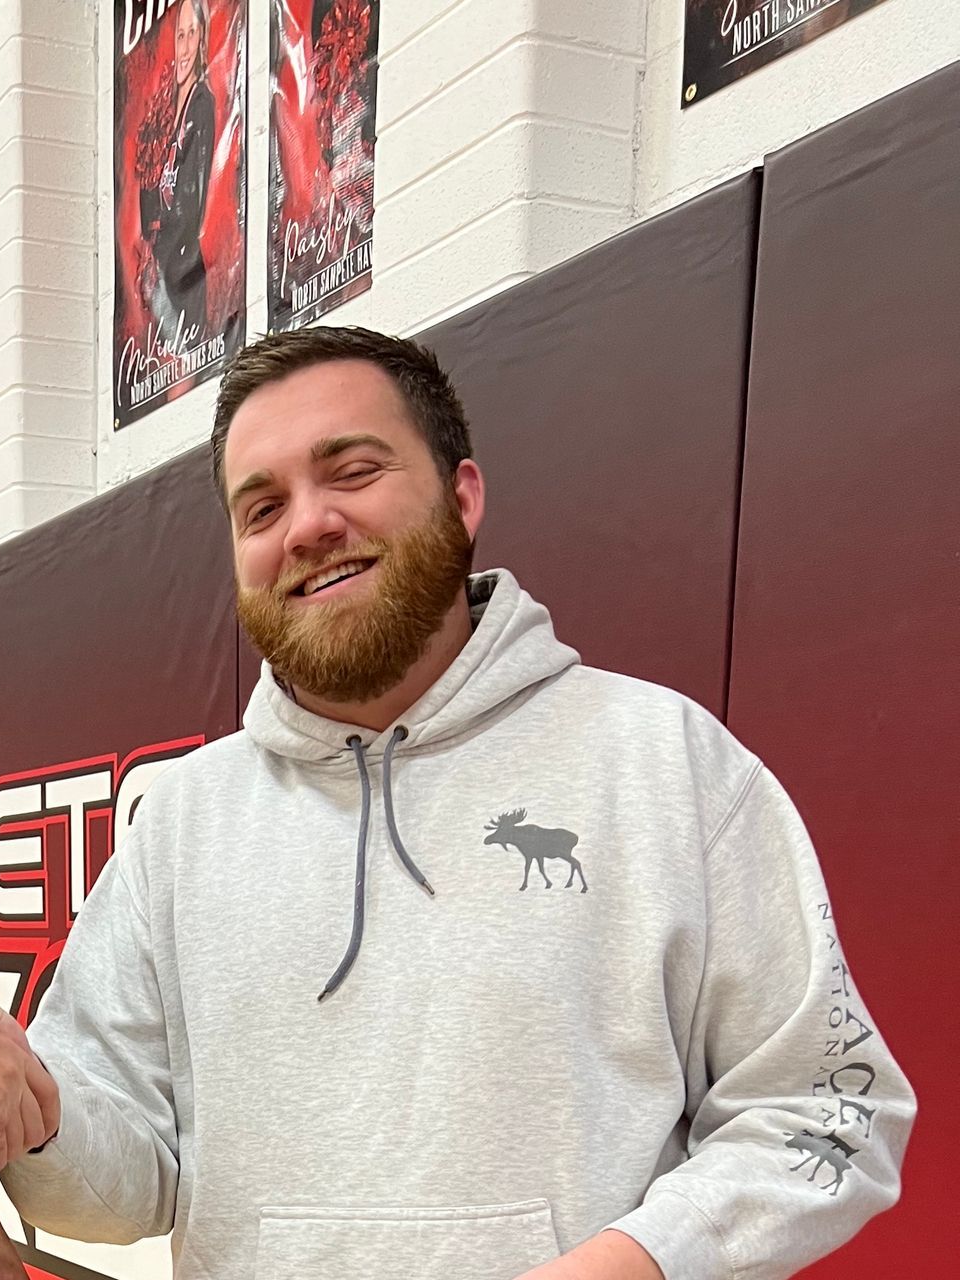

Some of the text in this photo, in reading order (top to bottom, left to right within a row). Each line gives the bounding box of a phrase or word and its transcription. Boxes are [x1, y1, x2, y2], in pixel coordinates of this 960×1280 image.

[732, 0, 780, 56] NORTH
[280, 191, 361, 299] Paisley
[291, 277, 318, 313] NORTH
[320, 254, 355, 297] SANPETE
[207, 332, 226, 363] 2025
